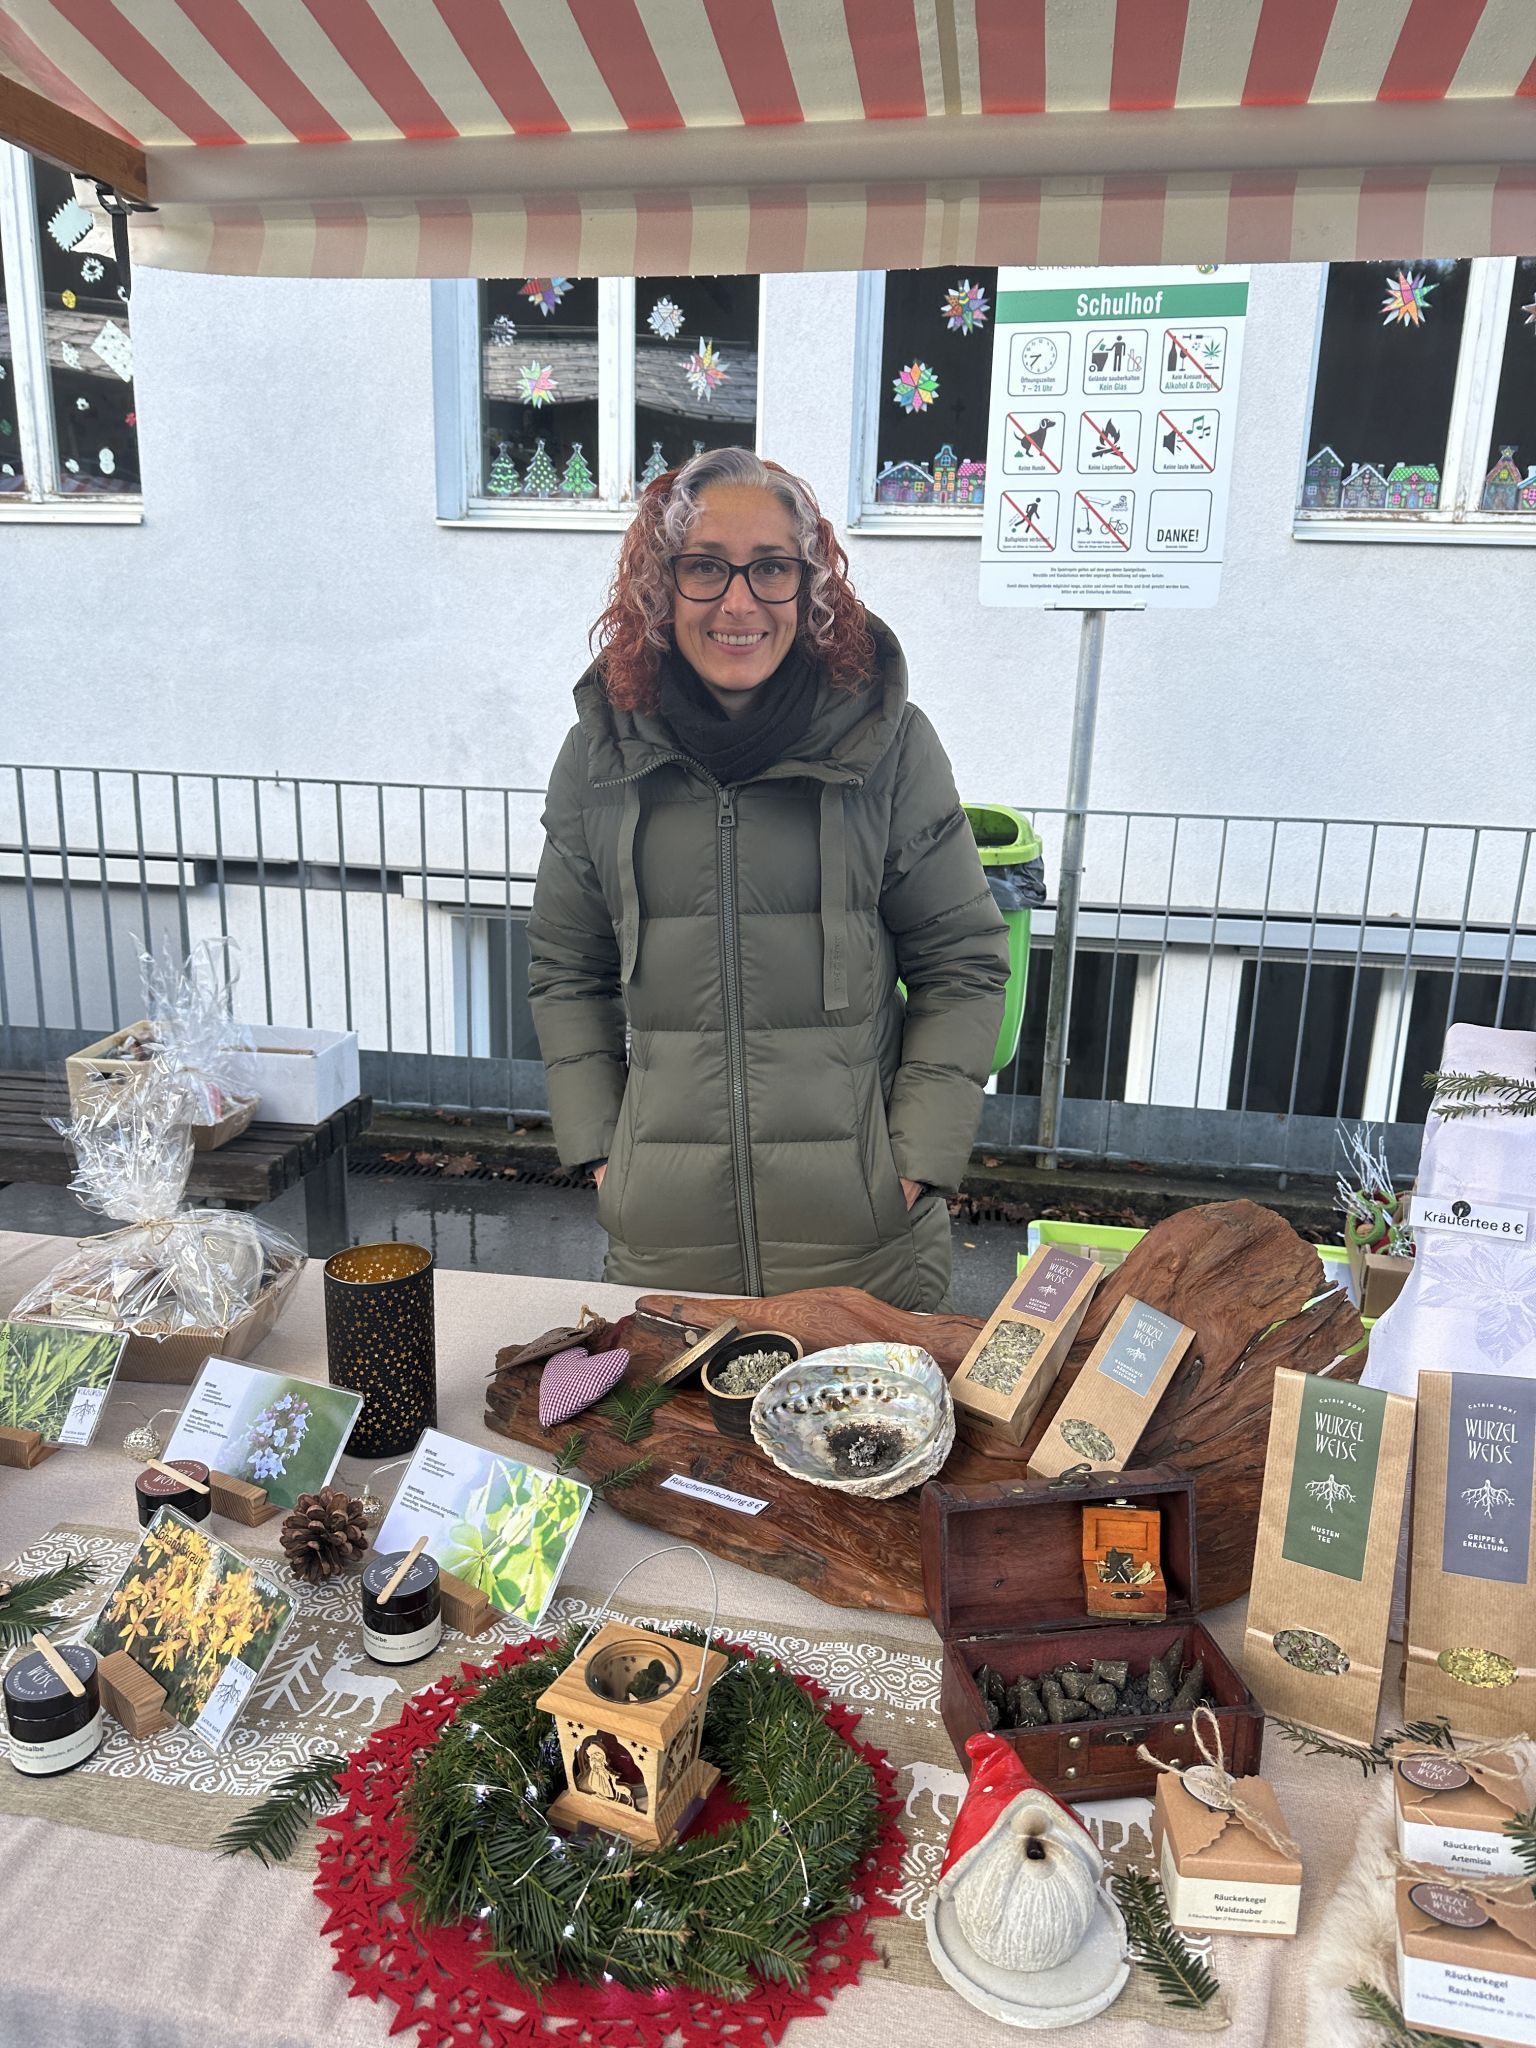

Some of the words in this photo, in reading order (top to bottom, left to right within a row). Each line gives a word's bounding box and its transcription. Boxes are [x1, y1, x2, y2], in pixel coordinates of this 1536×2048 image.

[1076, 291, 1164, 317] Schulhof
[1099, 383, 1113, 391] Kein
[1114, 383, 1127, 391] Glas
[1165, 381, 1188, 390] Alkohol
[1156, 528, 1199, 543] DANKE!
[1424, 1211, 1498, 1231] Kräutertee
[1502, 1222, 1511, 1233] 8
[1514, 1224, 1524, 1235] €
[1132, 1329, 1157, 1349] WEISE
[1136, 1319, 1164, 1341] WURZEL
[1314, 1411, 1364, 1443] WURZEL
[1465, 1418, 1519, 1444] WURZEL
[1315, 1433, 1358, 1462] WEISE
[1468, 1440, 1513, 1465] WEISE
[669, 1477, 747, 1507] Räuchermischung
[1311, 1525, 1340, 1539] HUSTEN
[1317, 1534, 1331, 1544] TEE
[1467, 1533, 1496, 1544] GRIPPE
[1498, 1537, 1505, 1545] &
[1462, 1540, 1509, 1553] ERKÄLTUNG
[1451, 1854, 1492, 1866] Artemisia
[1215, 1905, 1263, 1916] Waldzauber
[1448, 1985, 1506, 2004] Rauhnächte
